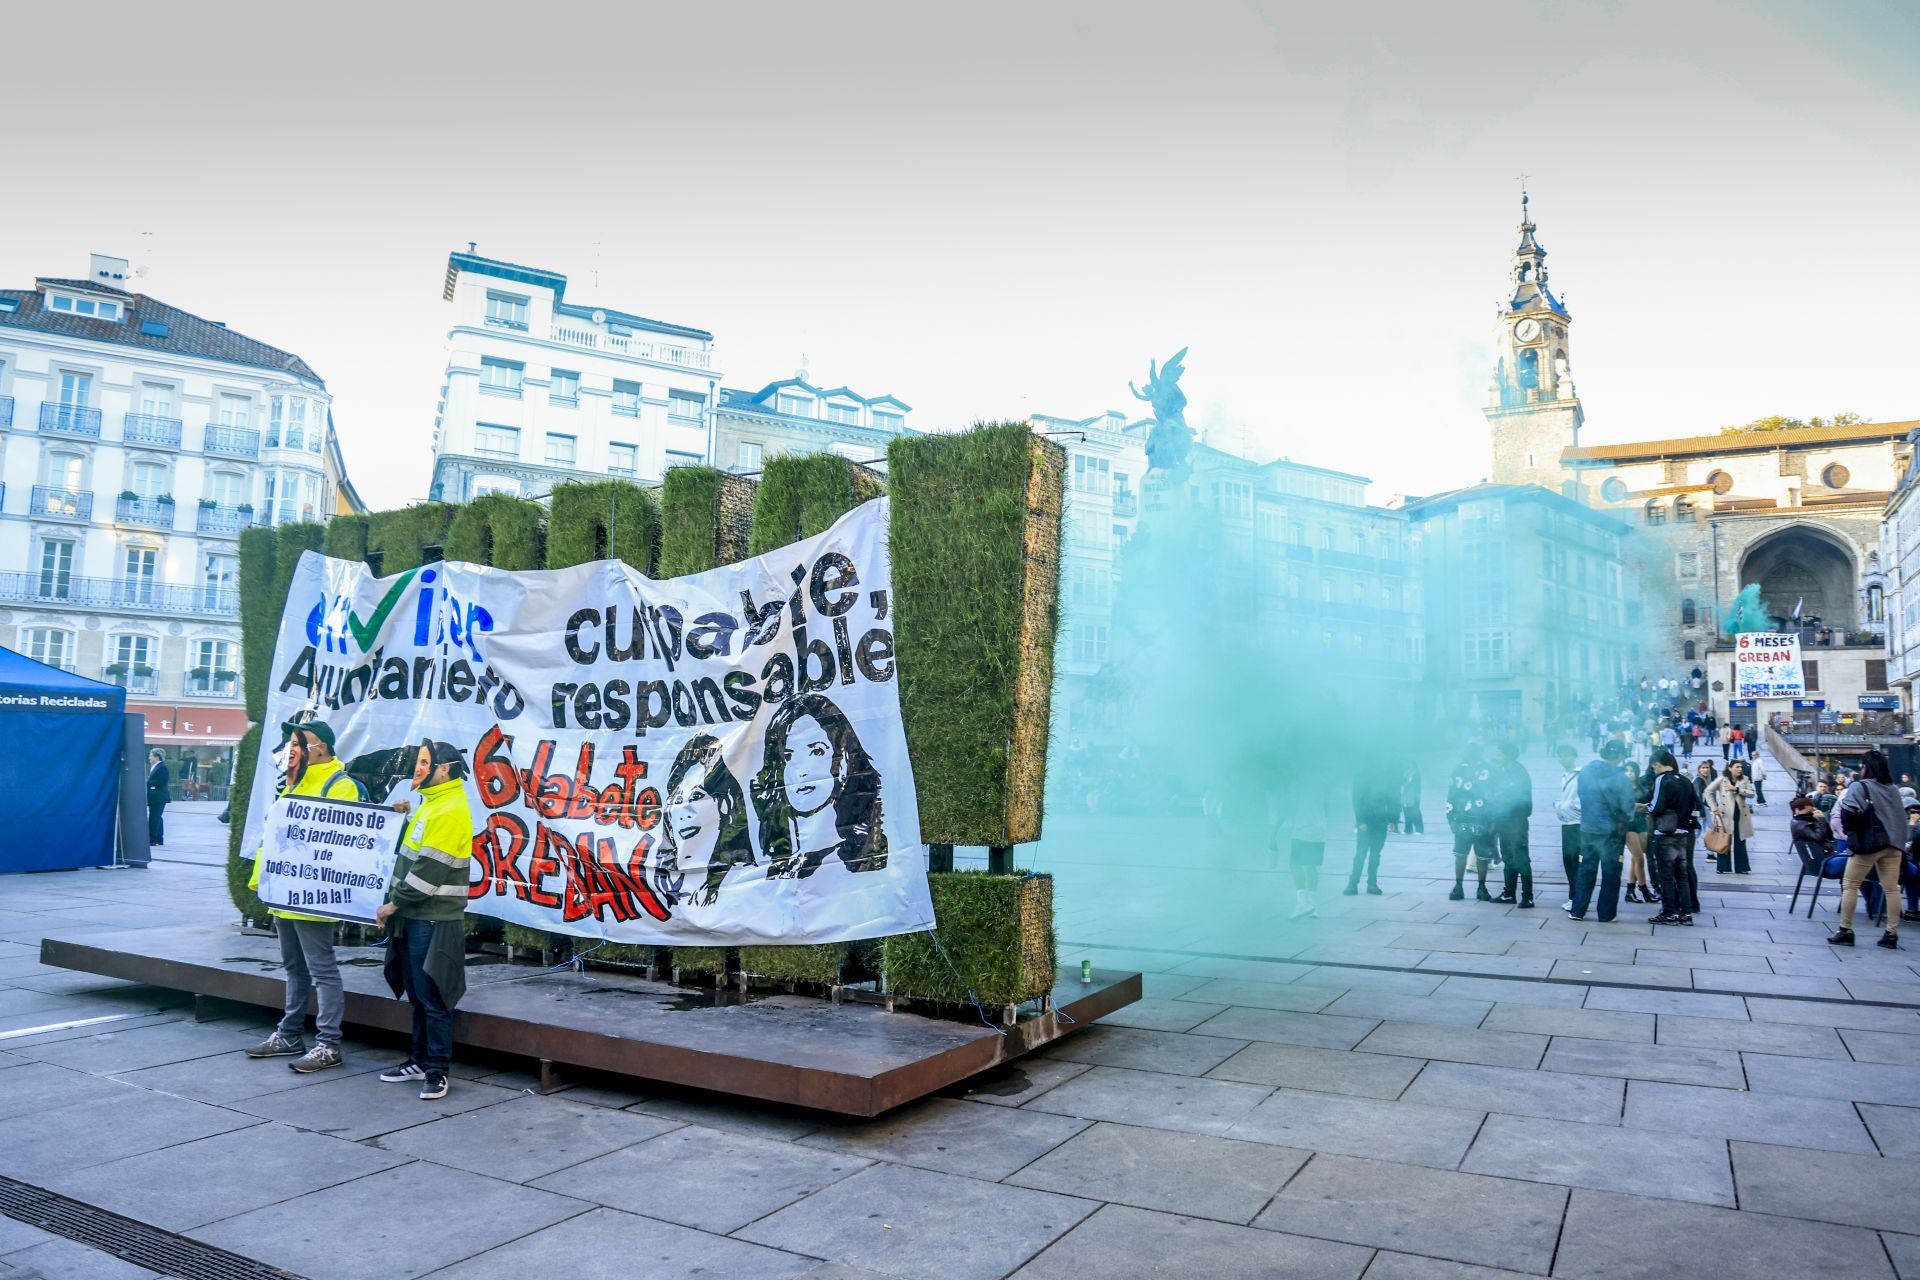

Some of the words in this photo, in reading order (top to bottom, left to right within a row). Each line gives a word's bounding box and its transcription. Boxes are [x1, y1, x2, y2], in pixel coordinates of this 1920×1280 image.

[1739, 635, 1749, 648] 6
[1755, 637, 1794, 647] MESES
[1739, 650, 1791, 662] GREBAN
[552, 616, 895, 737] responsable
[40, 696, 107, 708] Recicladas
[473, 724, 521, 809] 6
[286, 801, 311, 820] Nos
[312, 807, 364, 827] reimos
[366, 812, 385, 830] de
[307, 828, 375, 850] jardiner@s
[314, 849, 318, 860] y
[320, 849, 333, 861] de
[266, 860, 297, 877] tod@s
[321, 867, 384, 890] Vitorian@s
[288, 890, 299, 905] Ja
[302, 890, 313, 905] Ja
[316, 889, 328, 904] Ja
[330, 888, 342, 903] Ja
